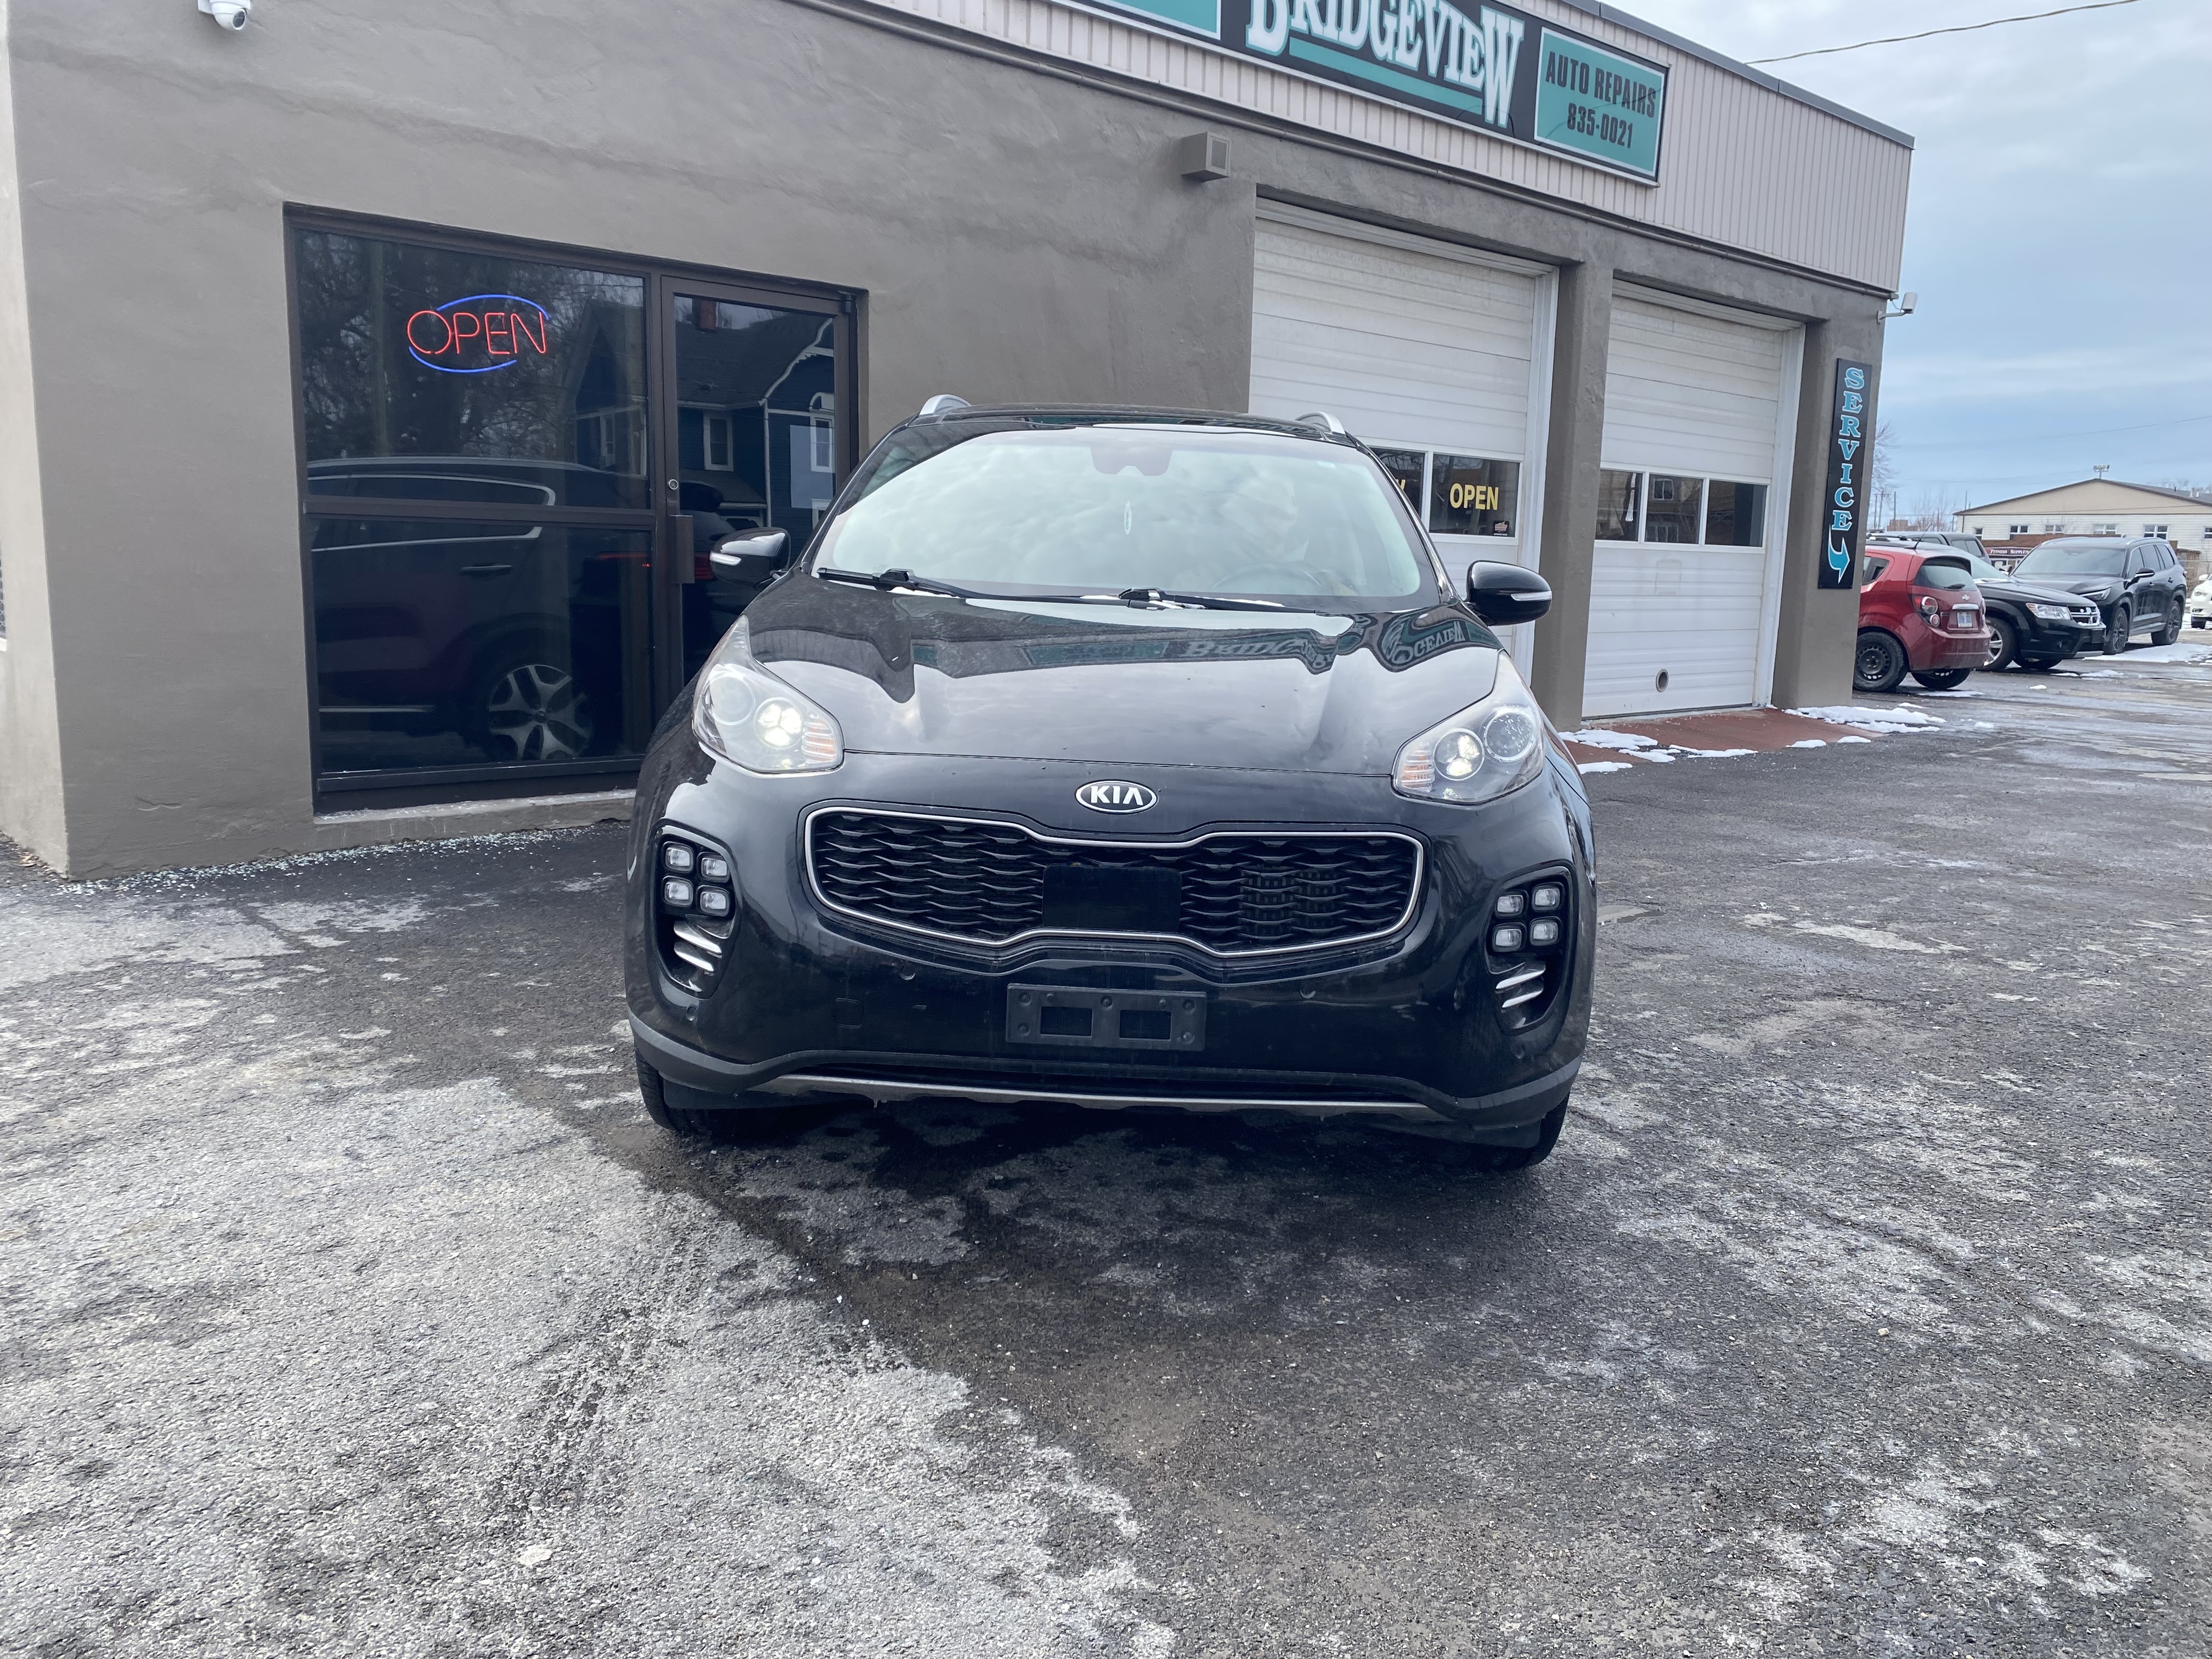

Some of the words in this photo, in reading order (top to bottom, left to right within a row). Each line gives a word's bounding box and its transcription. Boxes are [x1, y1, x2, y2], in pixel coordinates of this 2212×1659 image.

[1545, 51, 1590, 94] AUTO
[1594, 67, 1656, 119] REPAIRS
[1567, 103, 1633, 149] 835-0021
[407, 309, 546, 355] OPEN
[1831, 367, 1865, 532] SERVICE
[1449, 483, 1499, 510] OPEN
[1090, 786, 1143, 805] KIA
